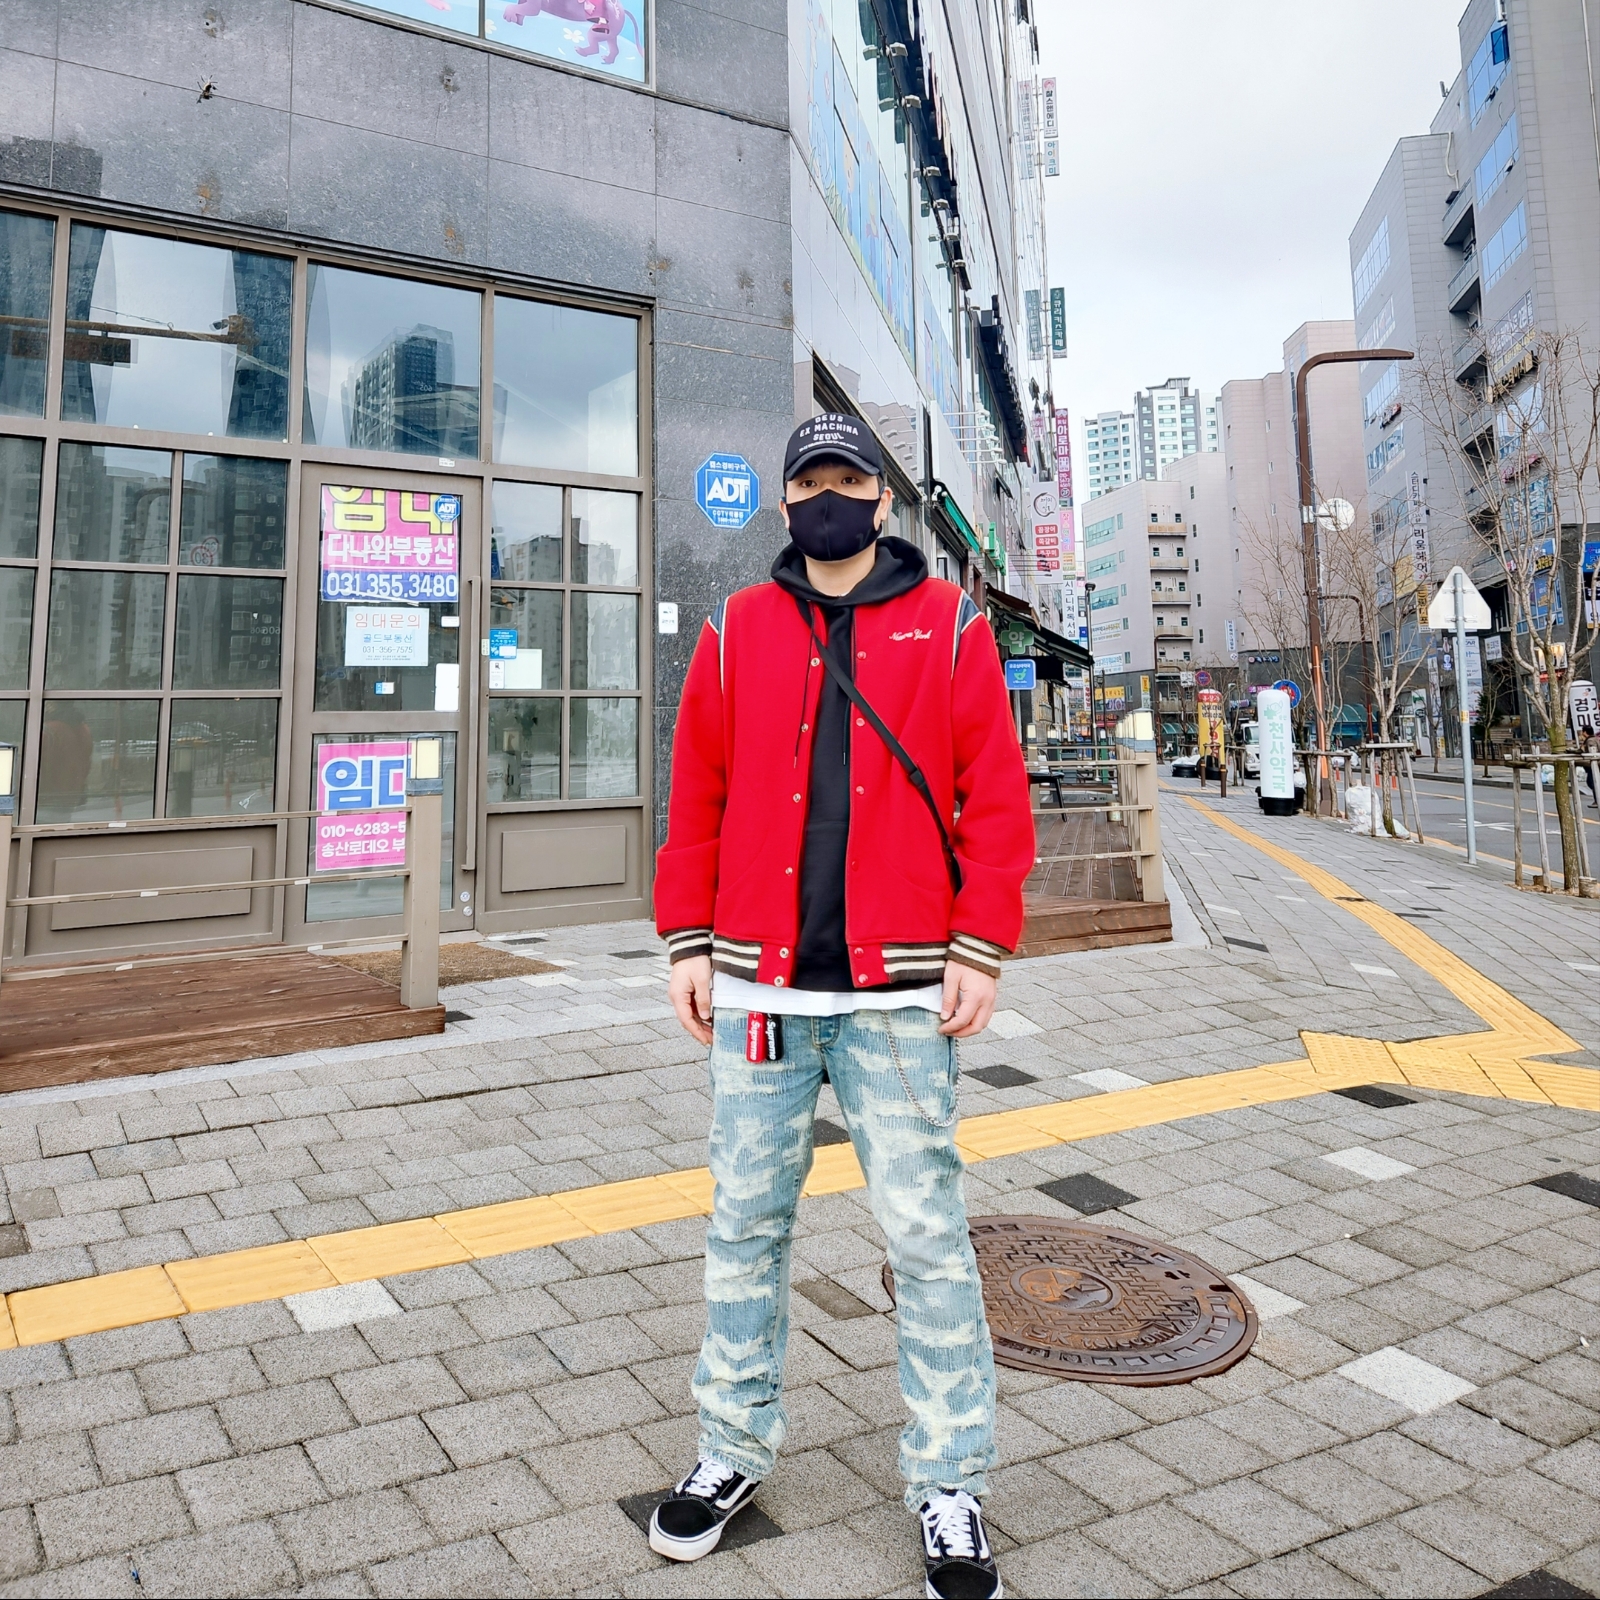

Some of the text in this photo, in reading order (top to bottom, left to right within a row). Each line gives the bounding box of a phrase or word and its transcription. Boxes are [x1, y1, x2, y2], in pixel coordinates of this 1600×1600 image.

[815, 414, 843, 423] DEUS
[799, 422, 859, 438] EX MACHINA
[813, 432, 844, 441] SEOUL
[706, 476, 750, 504] ADT
[438, 502, 457, 514] ADT
[327, 533, 455, 566] 다나와부동산
[1064, 581, 1076, 638] 시그니처독서실
[354, 613, 421, 629] 임대문의
[1008, 631, 1025, 648] 약
[362, 645, 413, 654] 031-356-7575
[1269, 722, 1287, 793] 천사약국
[321, 839, 390, 858] 송산로데오
[765, 1020, 777, 1061] Supreme
[1081, 1329, 1174, 1350] telecom
